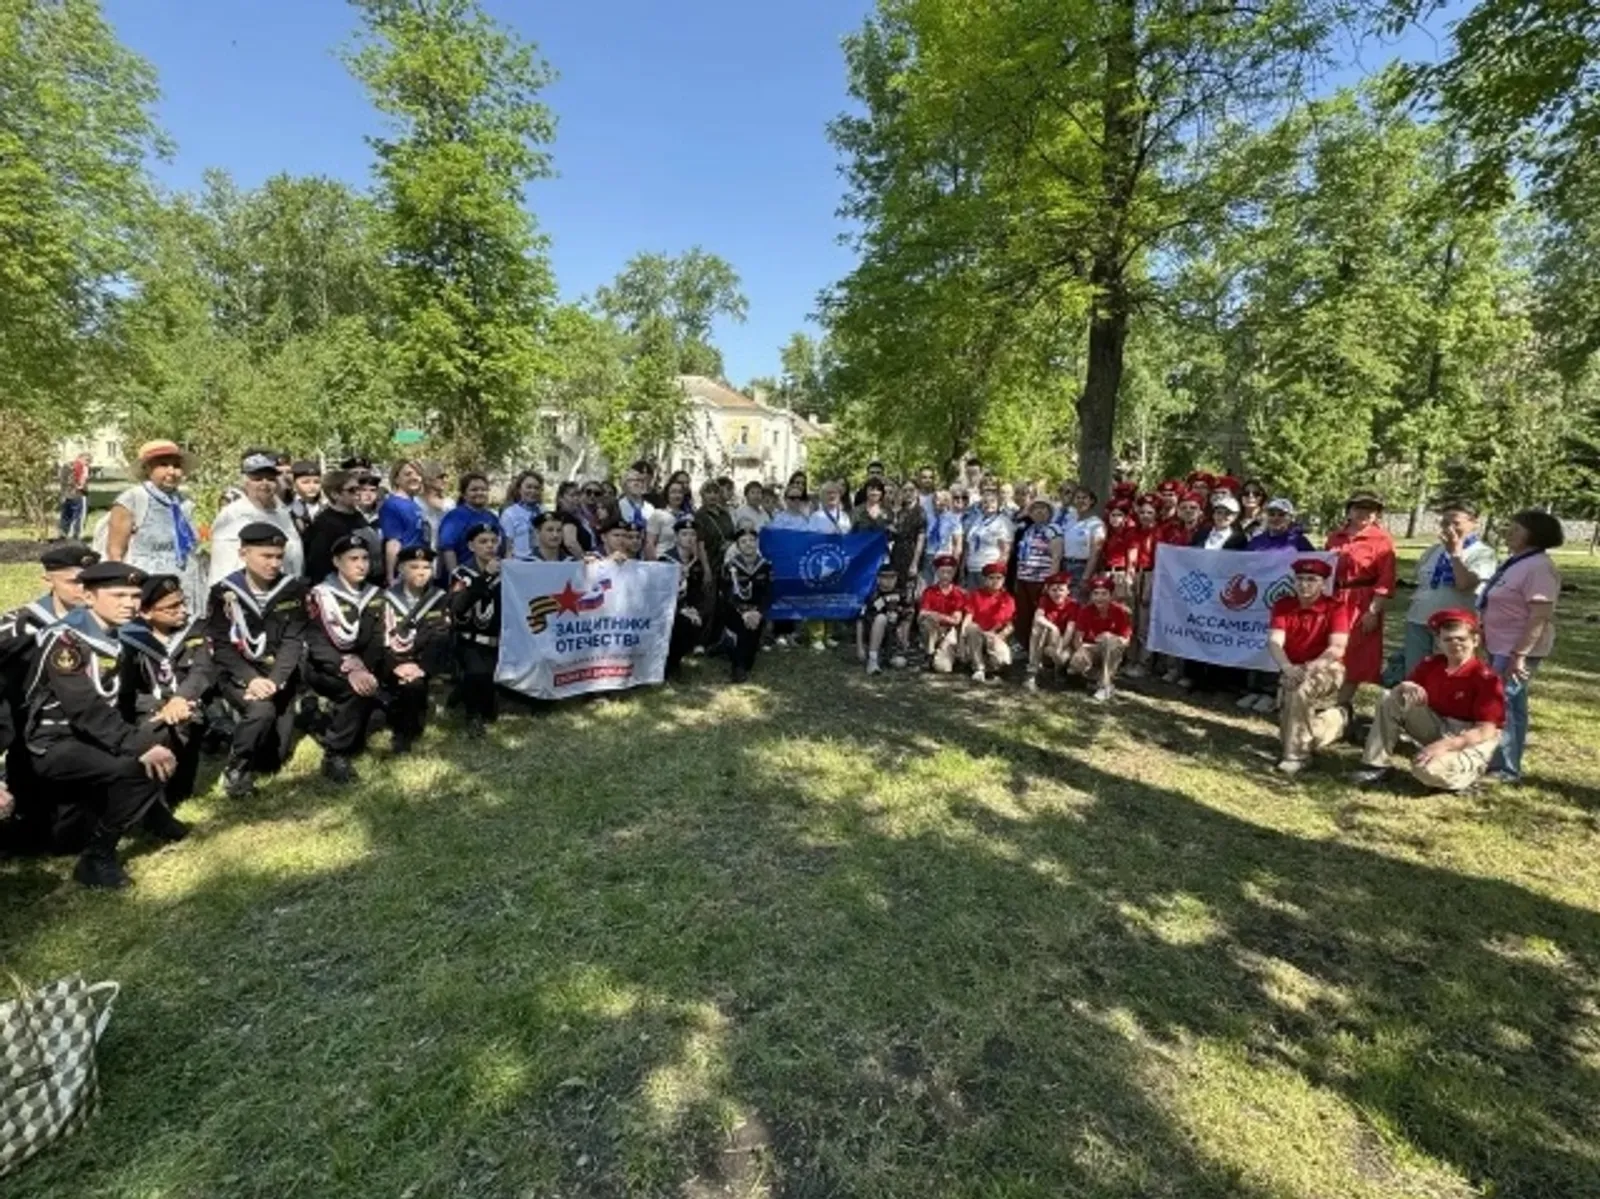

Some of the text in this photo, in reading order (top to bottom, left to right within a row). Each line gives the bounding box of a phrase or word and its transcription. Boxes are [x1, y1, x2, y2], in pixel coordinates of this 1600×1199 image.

[556, 616, 650, 637] ЗАЩИТНИКИ
[1164, 623, 1233, 647] НАРОДОВ
[556, 632, 640, 653] ОТЕЧЕСТВА
